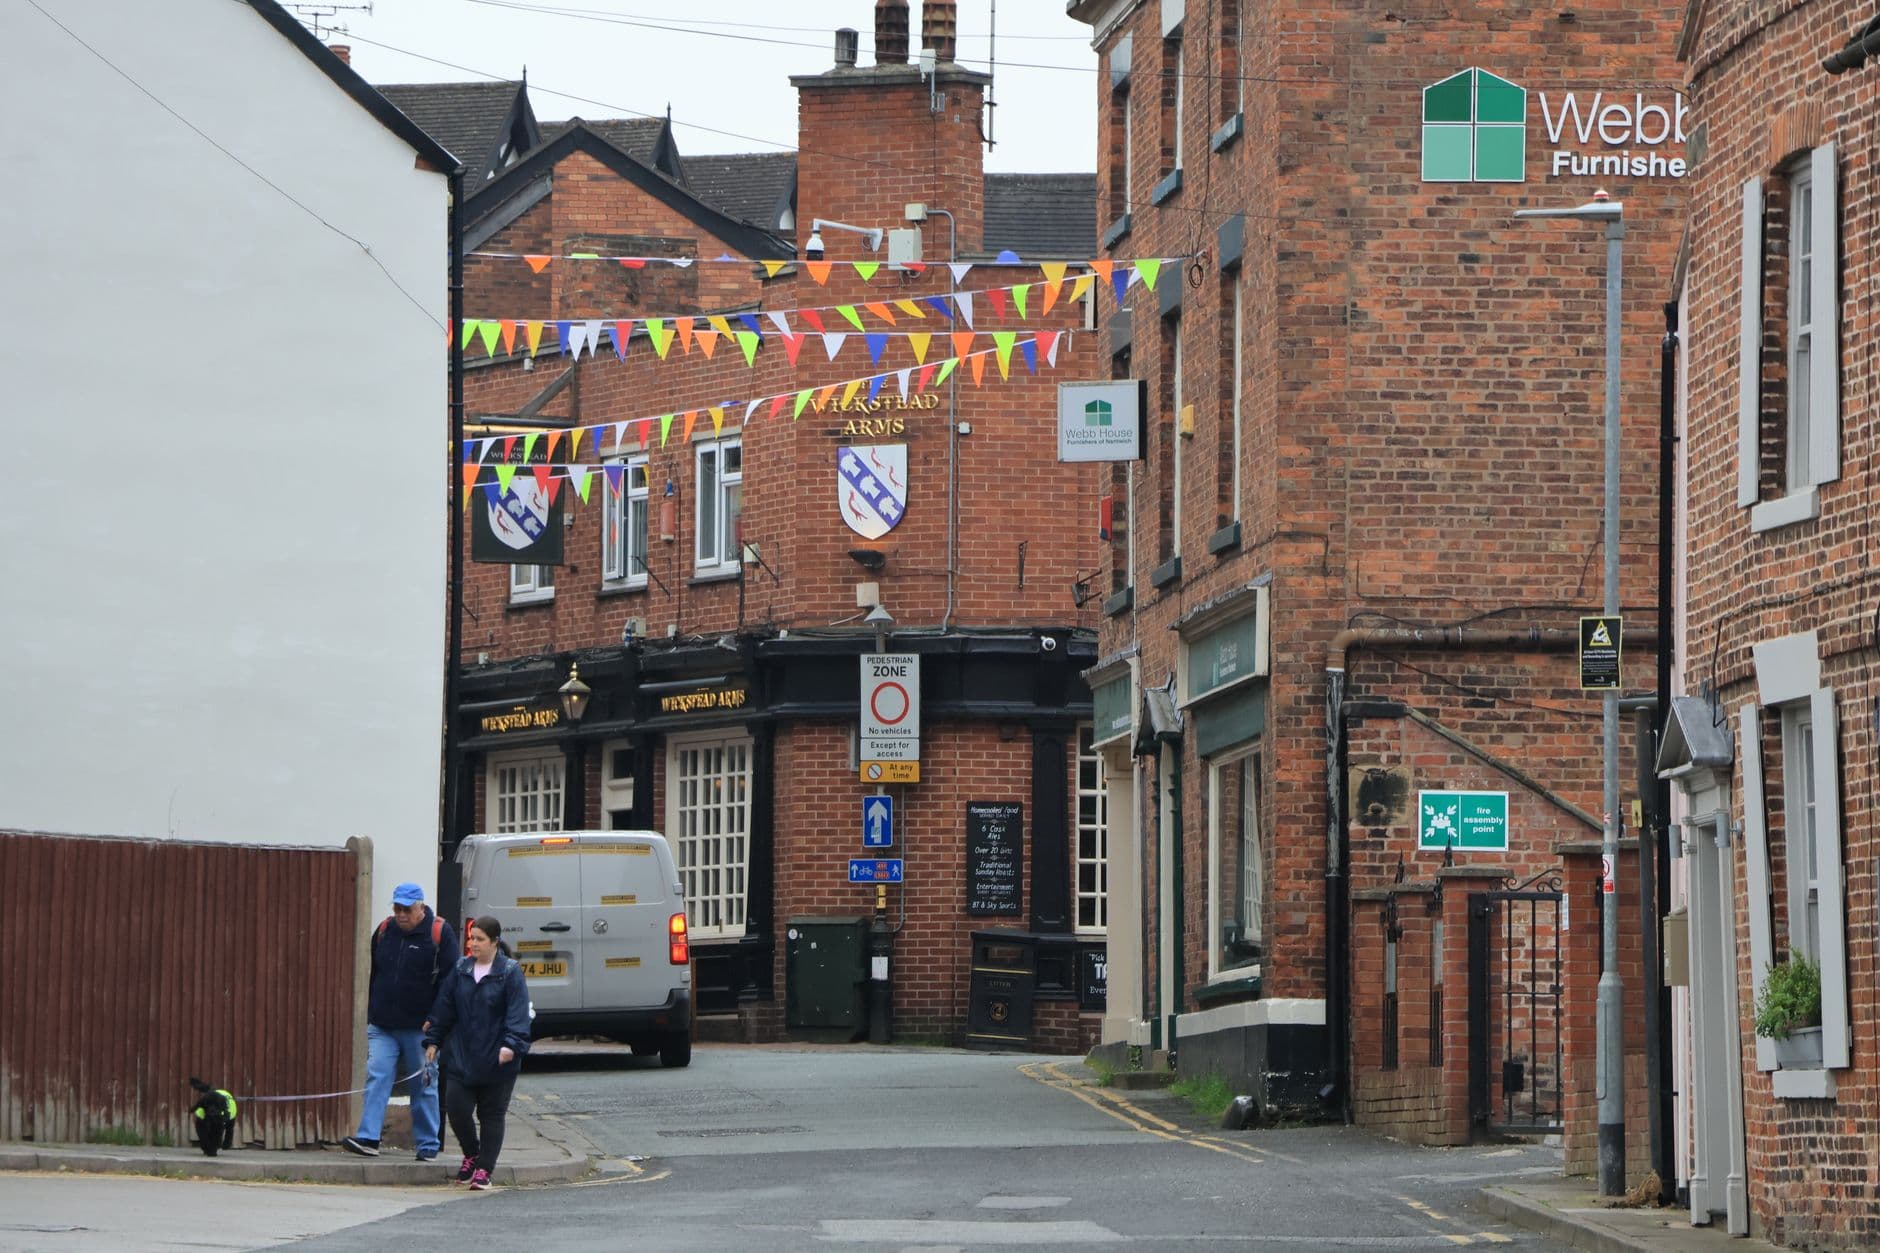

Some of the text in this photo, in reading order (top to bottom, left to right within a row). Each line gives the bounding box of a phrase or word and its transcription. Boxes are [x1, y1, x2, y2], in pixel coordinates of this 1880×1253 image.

[1552, 151, 1689, 177] Furnishe
[844, 418, 905, 437] ARMS
[1065, 428, 1133, 439] Webb House
[866, 656, 913, 664] PEDESTRIAN
[873, 666, 907, 677] ZONE
[718, 689, 746, 708] ARMS
[533, 709, 559, 727] ARMS
[880, 727, 912, 735] vehicles
[870, 741, 910, 750] Except for
[900, 764, 913, 772] any
[893, 771, 910, 779] time
[1463, 816, 1504, 826] assembly
[1472, 826, 1495, 834] point
[539, 962, 562, 975] JHU
